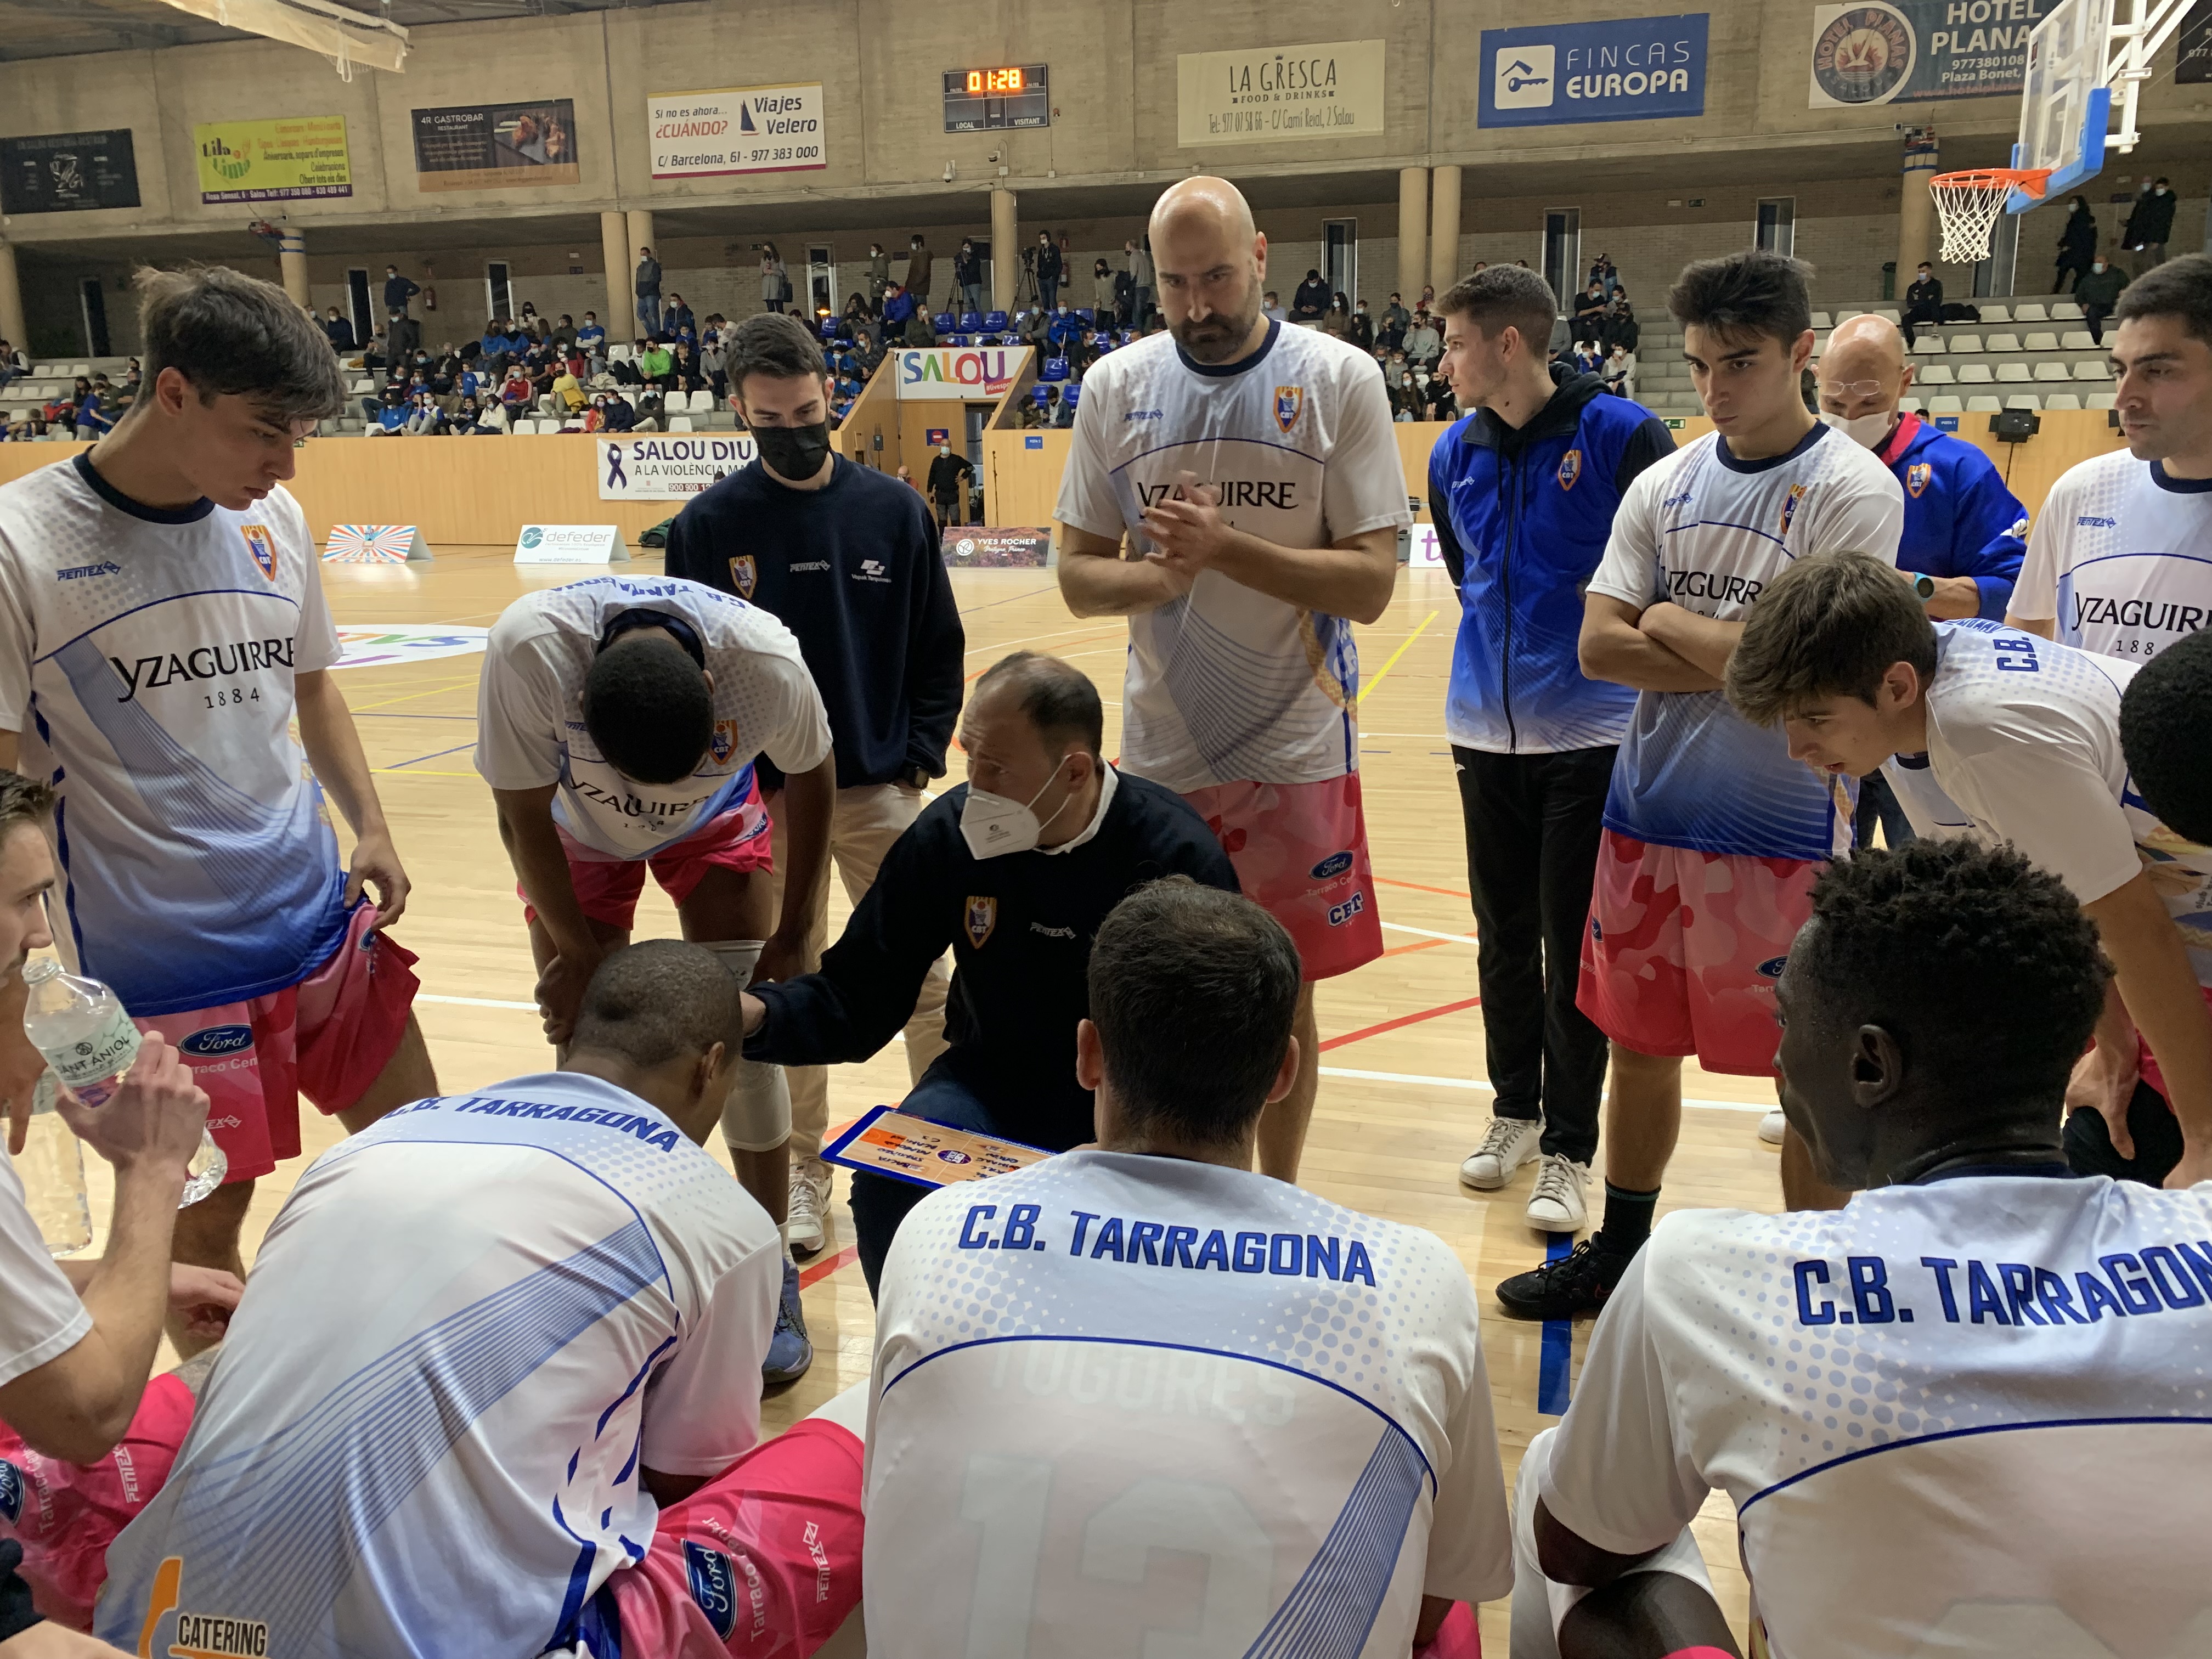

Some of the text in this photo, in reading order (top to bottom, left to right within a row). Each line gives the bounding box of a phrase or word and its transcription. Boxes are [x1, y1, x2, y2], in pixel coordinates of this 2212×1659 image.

[1947, 0, 2042, 25] HOTEL
[1567, 41, 1690, 70] FINCAS
[1952, 55, 2025, 70] 977380108
[969, 69, 1020, 92] 01:28
[1230, 59, 1336, 93] LA GRESCA
[1566, 69, 1688, 98] EUROPA
[1942, 71, 1976, 83] Plaza
[754, 96, 802, 114] Viajes
[1241, 94, 1269, 103] FOOD
[1285, 91, 1327, 100] DRINKS
[434, 113, 484, 123] GASTROBAR
[666, 110, 677, 119] no
[680, 109, 690, 117] es
[1014, 117, 1040, 126] VISITANT
[1222, 112, 1233, 133] 977
[656, 119, 728, 138] ¿CUÁNDO?
[766, 118, 817, 135] Velero
[658, 156, 668, 168] C/
[672, 153, 726, 166] Barcelona,
[752, 149, 769, 161] 977
[772, 148, 792, 160] 383
[796, 146, 818, 159] 000
[904, 351, 1005, 384] SALOU
[633, 440, 751, 460] SALOU DIU
[669, 483, 684, 492] 900
[685, 483, 698, 492] 900
[546, 531, 611, 543] defeder
[57, 563, 105, 582] PENTEX
[1993, 636, 2039, 672] C.B.
[205, 687, 259, 709] 1884
[1322, 856, 1347, 876] Ford
[1328, 891, 1363, 927] CBT
[92, 1035, 131, 1065] ANIOL
[199, 1030, 247, 1051] Ford
[454, 1097, 681, 1153] TARRAGONA
[958, 1204, 1376, 1288] C.B. TARRAGONA
[1793, 1256, 1915, 1326] C.B.
[113, 1447, 140, 1504] PENTEX
[695, 1547, 729, 1613] Ford
[746, 1562, 765, 1643] Tarraco
[178, 1615, 266, 1657] CATERING
